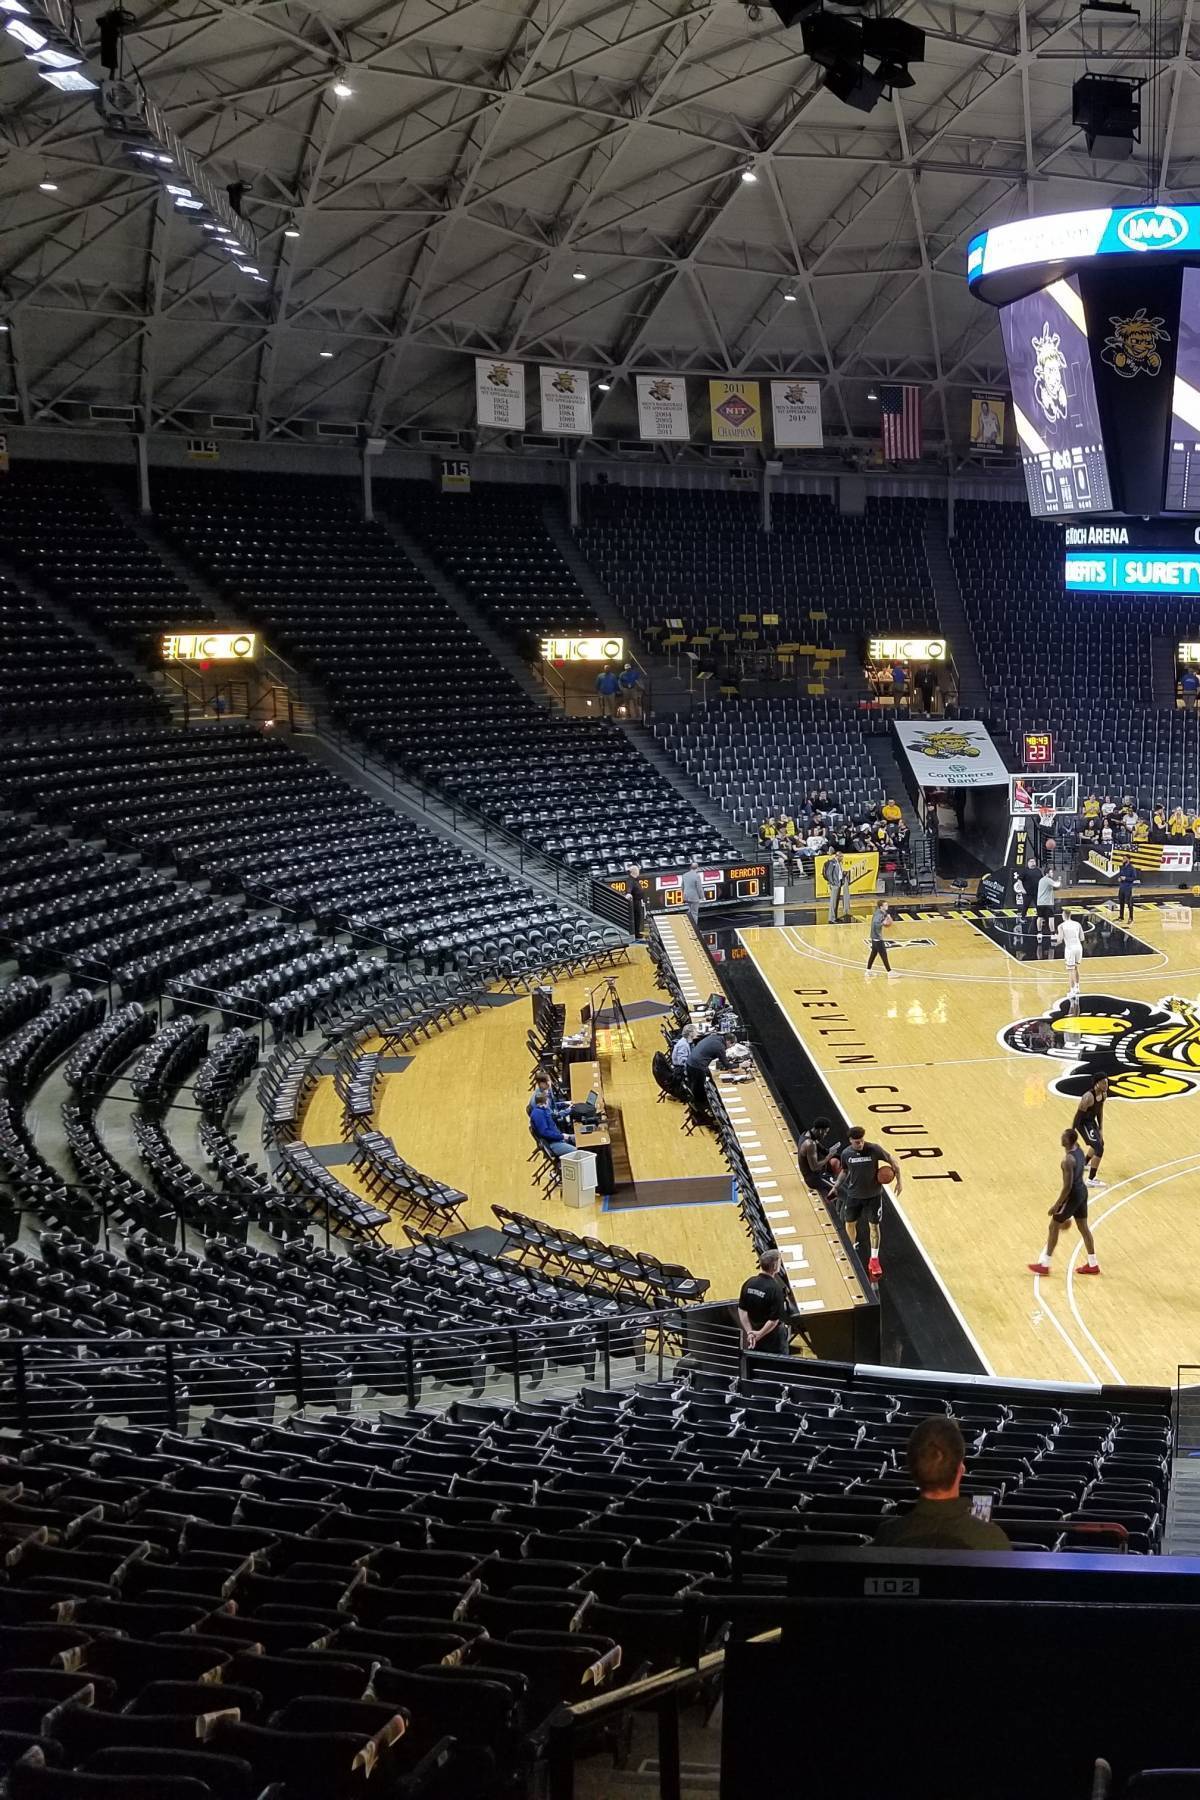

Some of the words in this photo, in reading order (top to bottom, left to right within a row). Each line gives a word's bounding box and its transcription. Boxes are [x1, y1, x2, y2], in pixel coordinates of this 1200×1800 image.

[723, 383, 745, 394] 2011
[725, 407, 747, 415] NIT
[718, 426, 756, 438] CHAMPIONS
[442, 461, 469, 476] 115
[1087, 526, 1129, 545] ARENA
[1026, 736, 1049, 745] 48:43
[1029, 746, 1046, 760] 23
[1016, 832, 1028, 865] WSU
[730, 867, 766, 879] BEARCATS
[793, 989, 878, 1064] DEVLIN
[856, 1085, 963, 1182] COURT
[870, 1580, 914, 1593] 102
